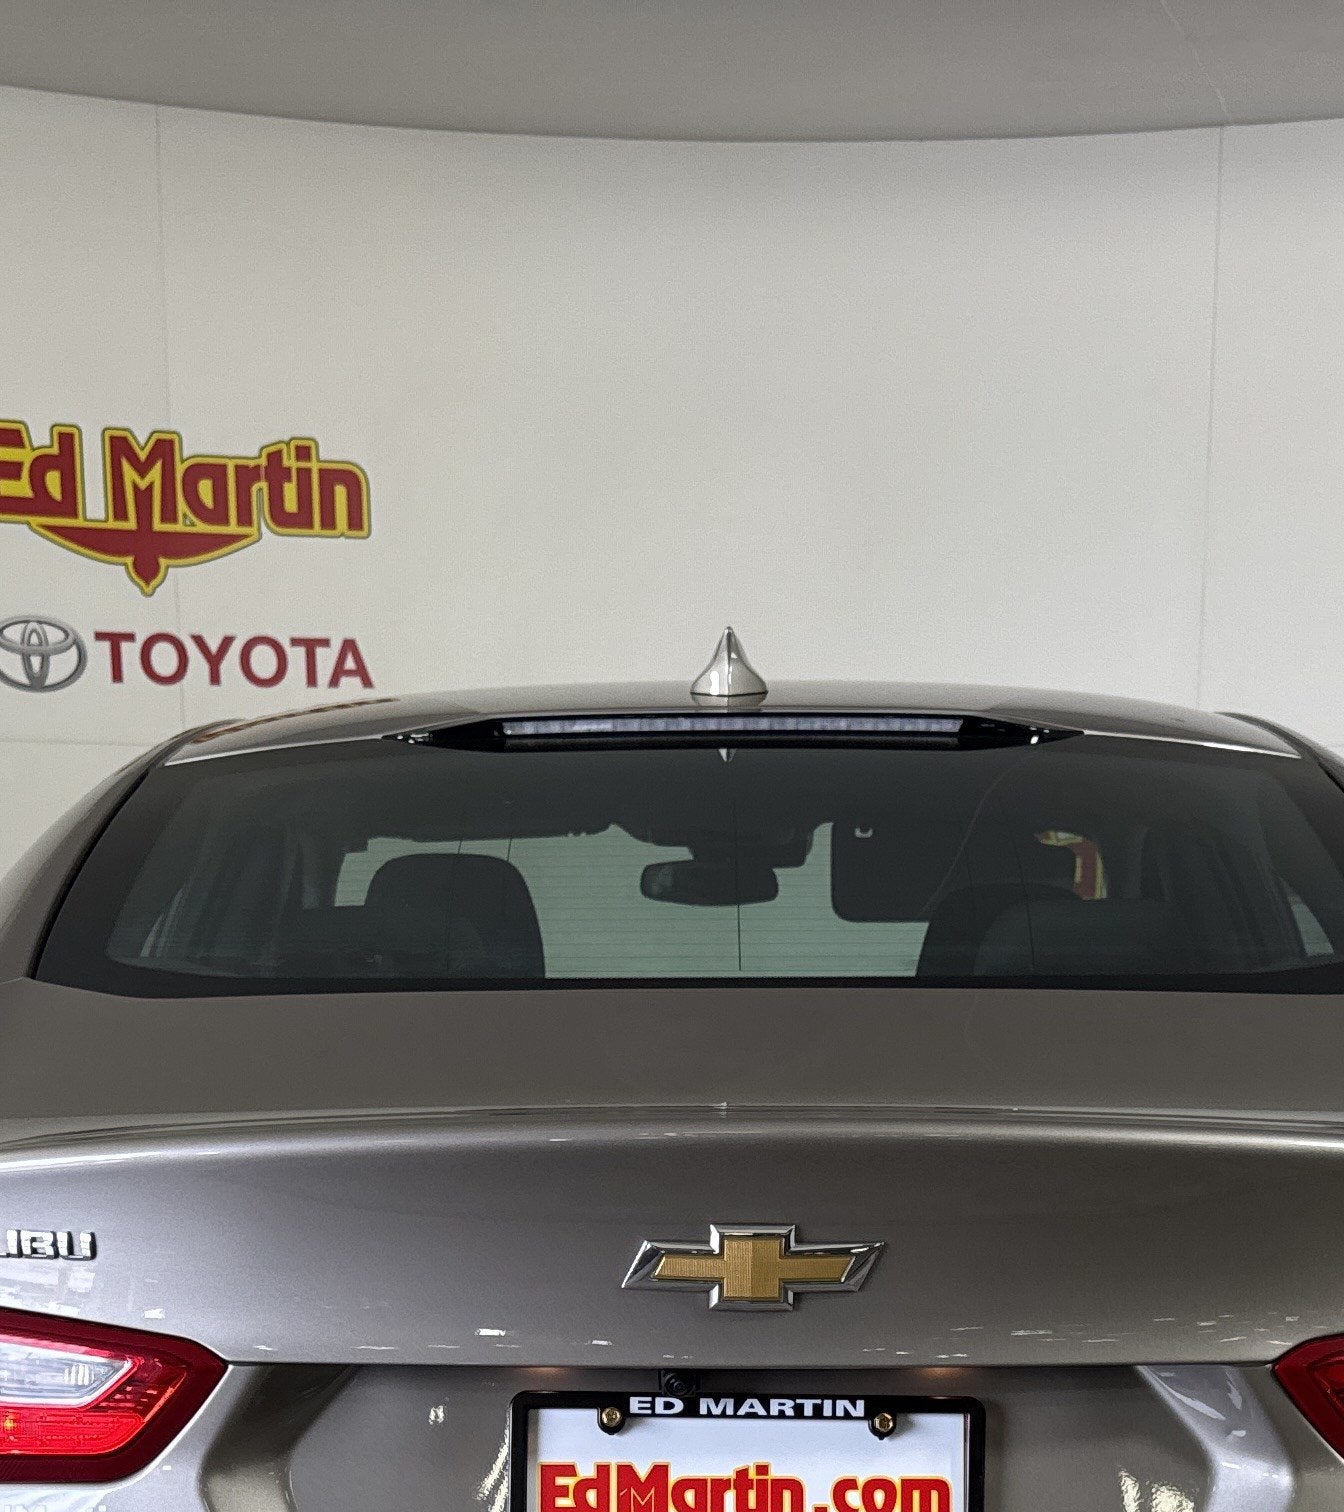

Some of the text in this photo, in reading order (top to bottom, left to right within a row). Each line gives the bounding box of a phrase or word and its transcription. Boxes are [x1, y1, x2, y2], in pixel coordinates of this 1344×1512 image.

[103, 426, 370, 538] Martin
[94, 630, 374, 689] TOYOTA
[629, 1396, 866, 1418] ED MARTIN
